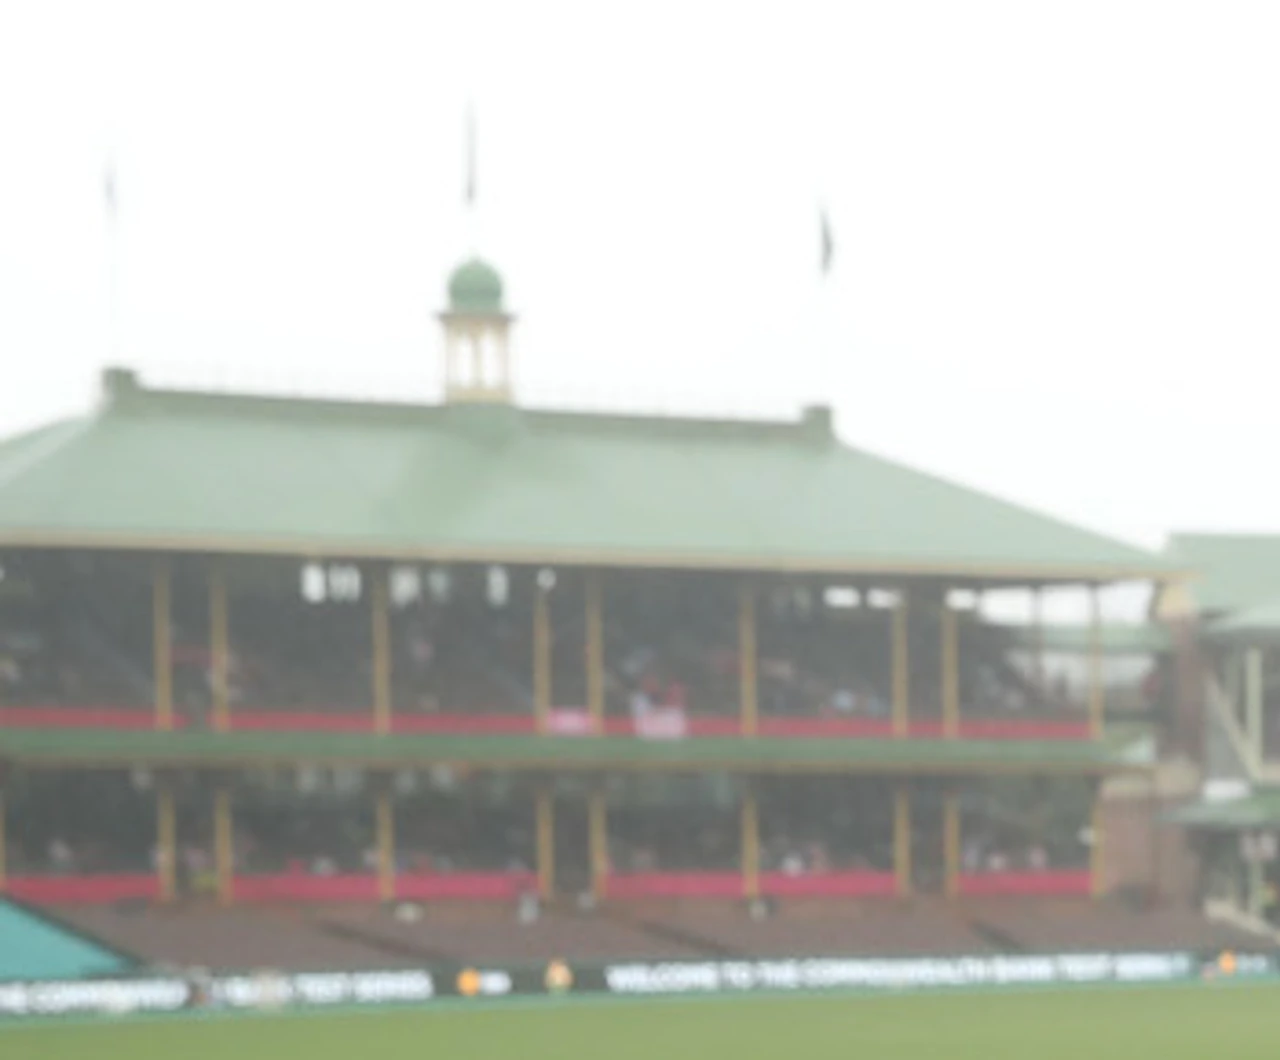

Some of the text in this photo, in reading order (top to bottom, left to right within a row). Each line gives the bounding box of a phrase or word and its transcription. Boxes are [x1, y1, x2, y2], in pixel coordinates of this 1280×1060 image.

[604, 962, 719, 993] WELCOME
[721, 960, 753, 990] TO
[755, 958, 800, 989] THE
[802, 956, 988, 988] COMMONWEALTH
